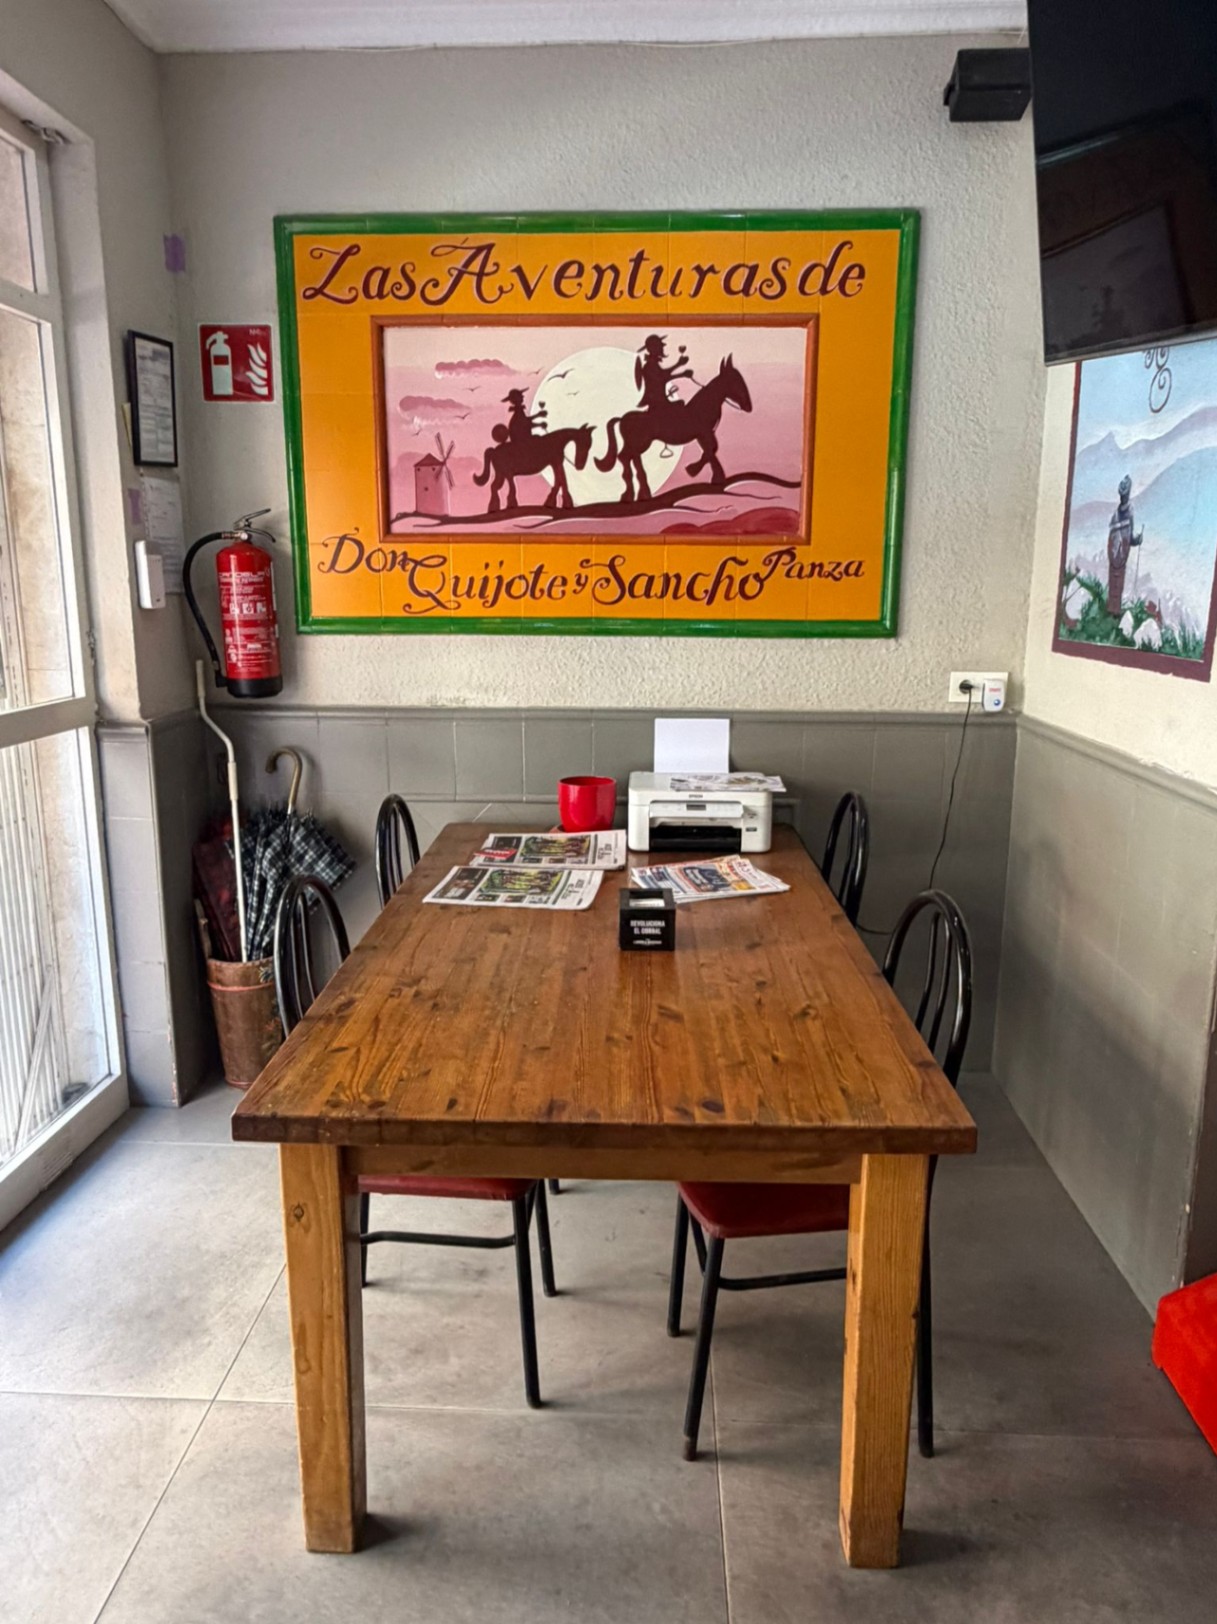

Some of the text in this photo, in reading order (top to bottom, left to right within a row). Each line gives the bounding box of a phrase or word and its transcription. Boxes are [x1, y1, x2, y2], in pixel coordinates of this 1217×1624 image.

[302, 237, 866, 306] Las Aventuras de
[317, 527, 866, 614] Don Quijote y Sancho Panza
